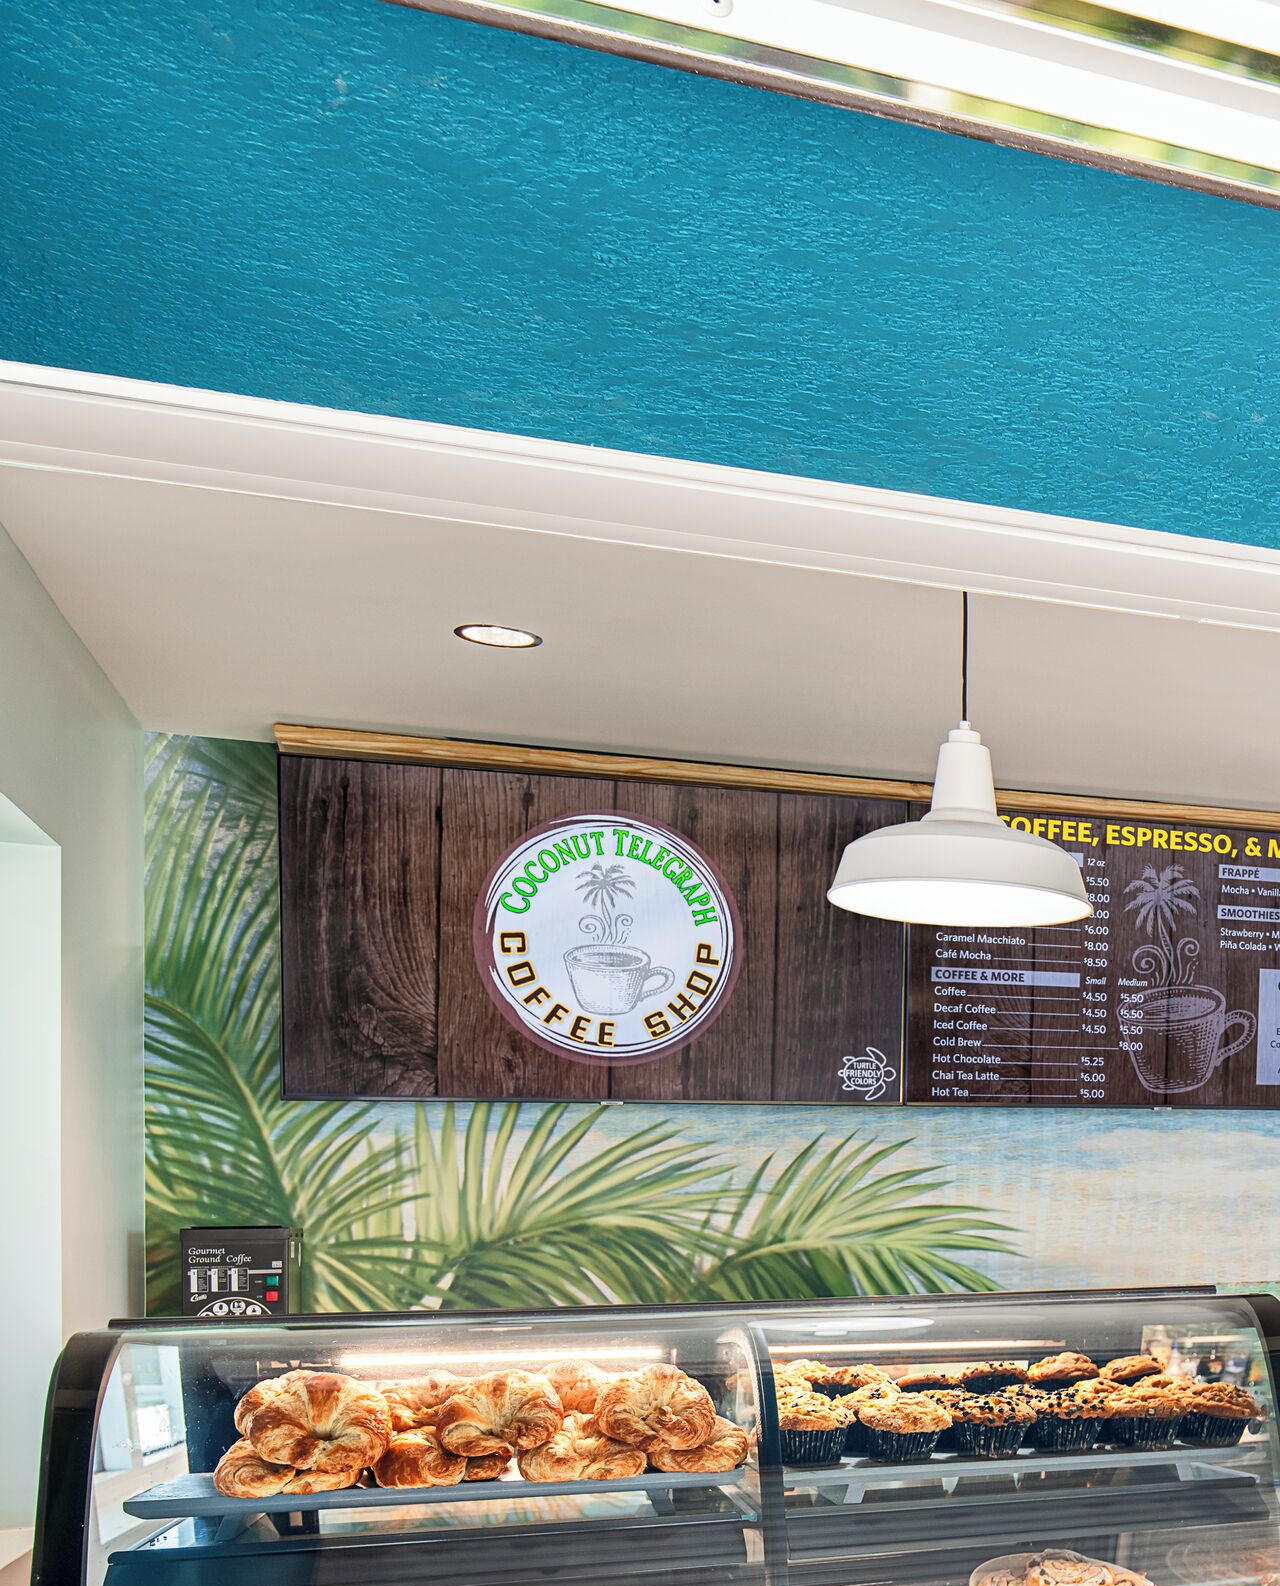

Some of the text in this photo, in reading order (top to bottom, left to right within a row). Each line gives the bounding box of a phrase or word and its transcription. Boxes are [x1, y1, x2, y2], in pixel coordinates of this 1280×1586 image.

[1106, 824, 1239, 858] ESPRESSO,
[1245, 837, 1262, 857] &
[500, 828, 717, 927] COCONUT TELEGRAPH
[1222, 868, 1260, 878] FRAPPÉ
[1087, 877, 1109, 886] $5.50
[1222, 885, 1249, 895] Mocha
[1221, 908, 1280, 920] SMOOTHIES
[1085, 925, 1109, 935] $6.00
[1221, 928, 1264, 938] Strawberry
[936, 932, 1108, 951] Caramel Macchiato $8.00
[1220, 941, 1237, 949] Piña
[1239, 942, 1266, 951] Colada
[936, 949, 1107, 967] Café Mocha $8.50
[935, 969, 1147, 987] COFFEE & MORE Small Medium
[499, 931, 720, 1048] COFFEE SHOP
[935, 986, 1143, 1003] Coffee $4.50 $5.50
[934, 1003, 1143, 1019] Decaf Coffee $4.50 $5.50
[934, 1020, 1143, 1034] Iced Coffee $4.50 $5.50
[933, 1037, 1143, 1050] Cold Brew $8.00
[933, 1054, 1104, 1066] Hot Chocolate $5.25
[932, 1071, 1105, 1082] Chai Tea Latte $6.00
[932, 1088, 1104, 1098] Hot Tea $5.00
[189, 1247, 225, 1255] Gourmet
[226, 1254, 251, 1265] Coffee
